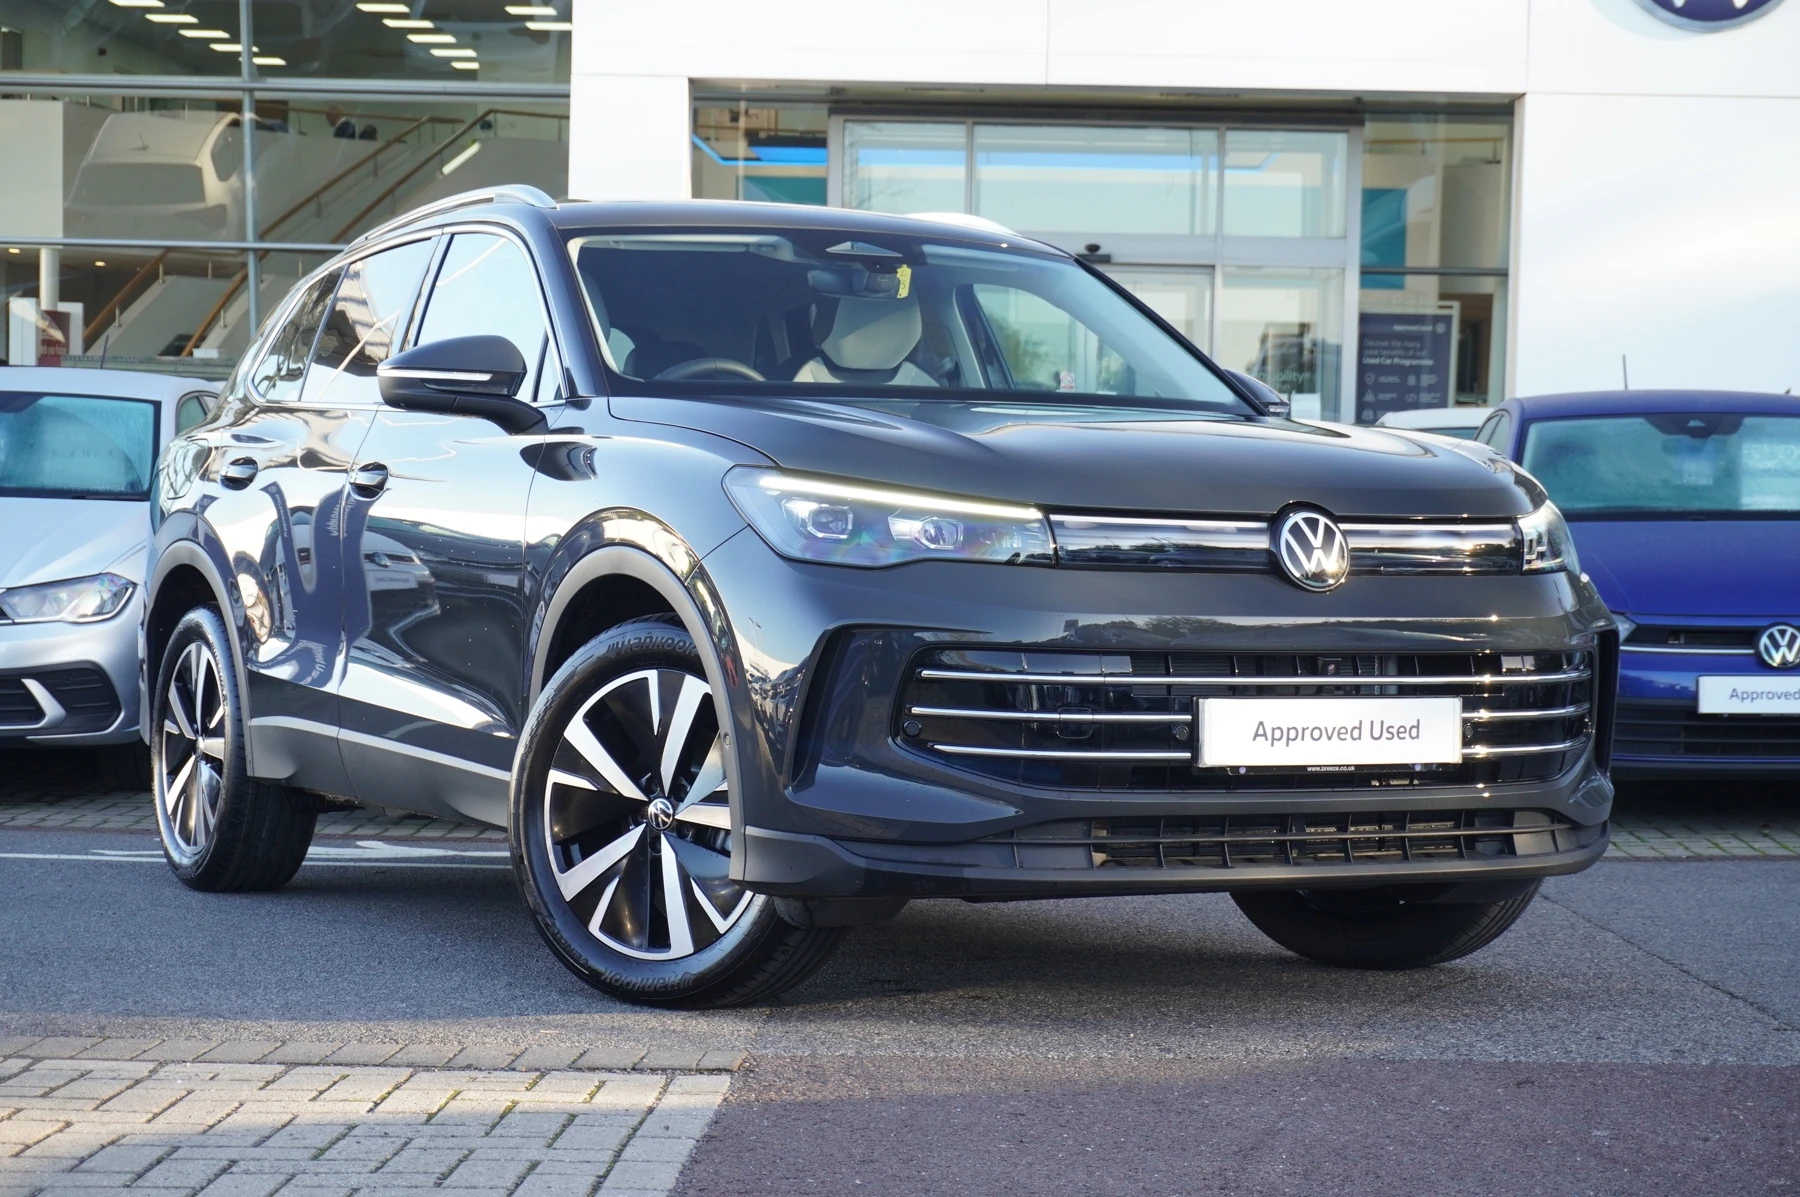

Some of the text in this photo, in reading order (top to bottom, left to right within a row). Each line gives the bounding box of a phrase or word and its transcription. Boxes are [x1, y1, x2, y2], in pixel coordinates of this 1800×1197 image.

[1362, 356, 1379, 365] Used
[1380, 356, 1392, 365] Car
[1729, 688, 1800, 703] Approved
[1252, 719, 1420, 747] Approved Used
